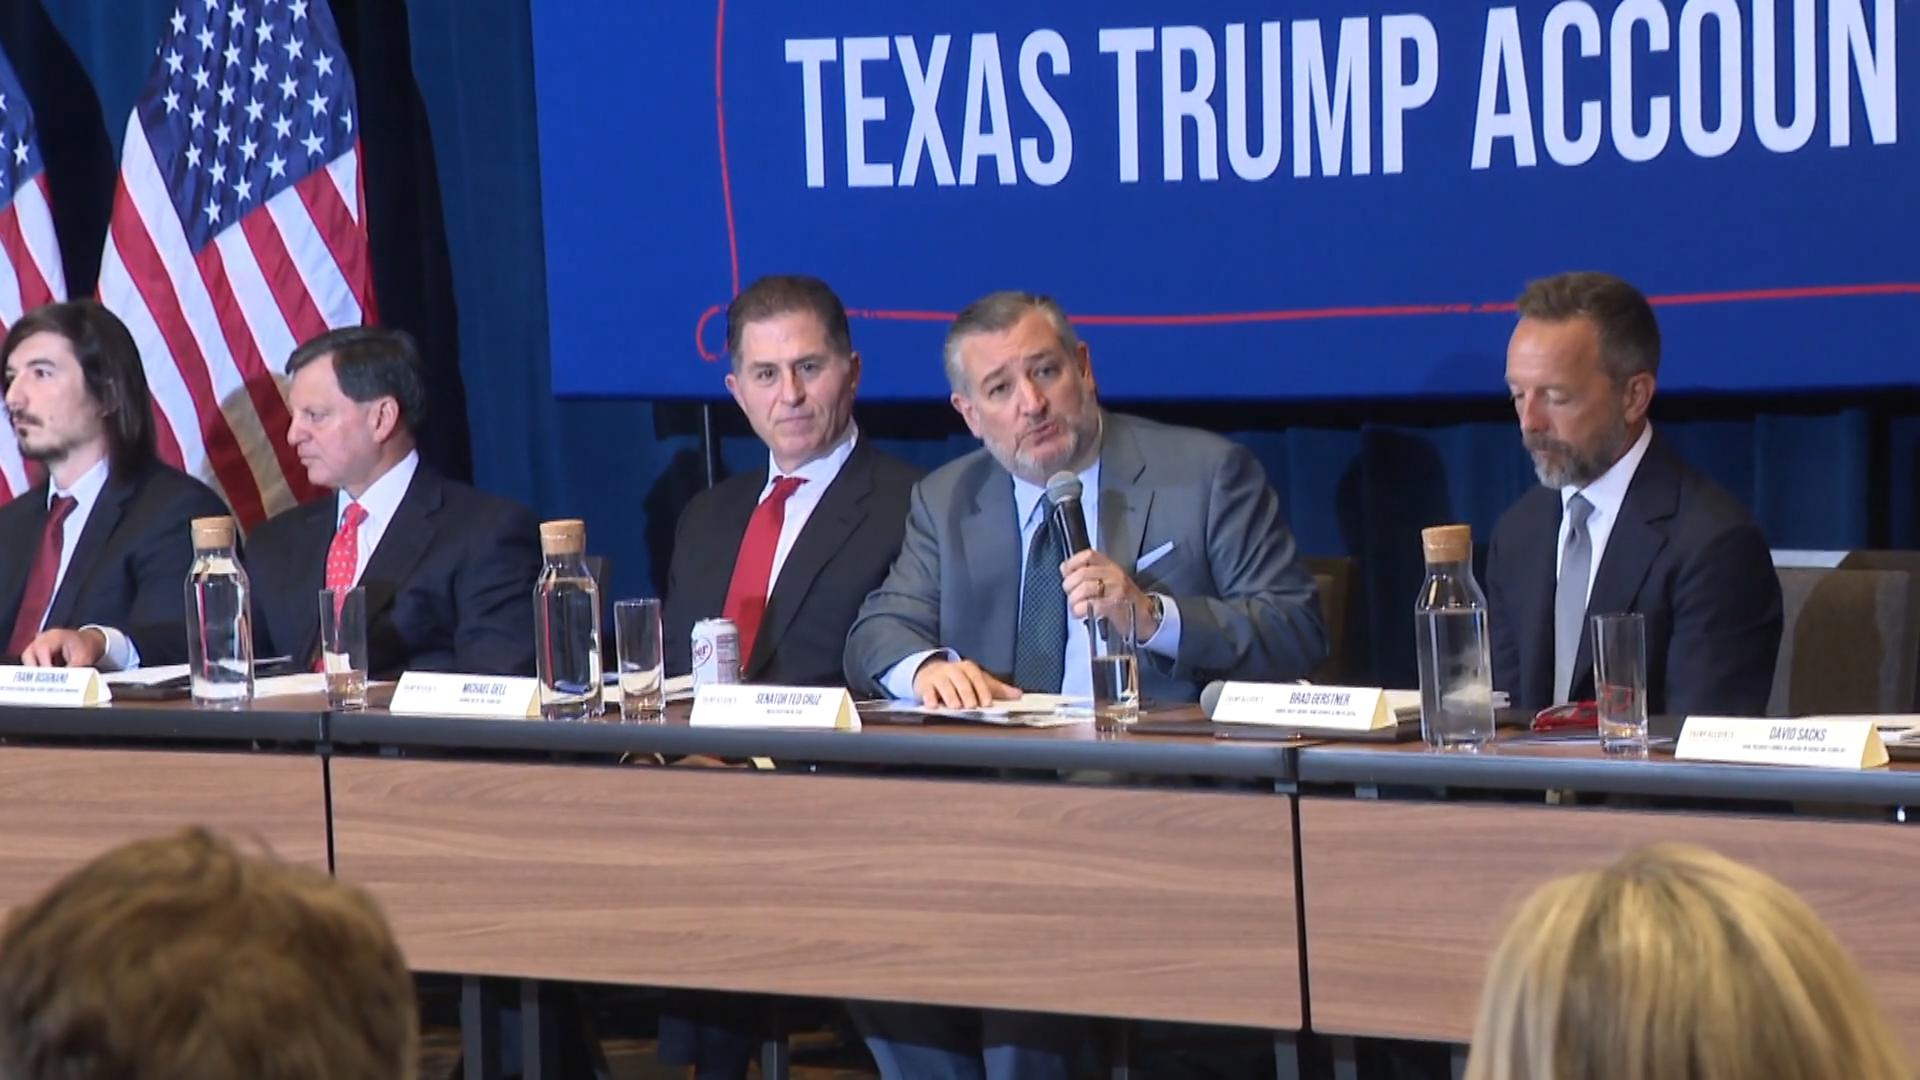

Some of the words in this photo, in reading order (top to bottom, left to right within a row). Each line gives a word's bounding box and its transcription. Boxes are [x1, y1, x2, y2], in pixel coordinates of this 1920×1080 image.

[785, 28, 1074, 188] TEXAS
[1098, 13, 1439, 183] TRUMP
[1470, 0, 1899, 170] ACCOUN
[755, 692, 788, 705] SENATOR
[787, 693, 803, 705] TED
[803, 693, 822, 706] CRUZ
[1289, 691, 1311, 705] BRAD
[1311, 692, 1351, 706] GERSTNER
[1769, 726, 1797, 740] DAVID
[1797, 727, 1827, 742] SACKS
